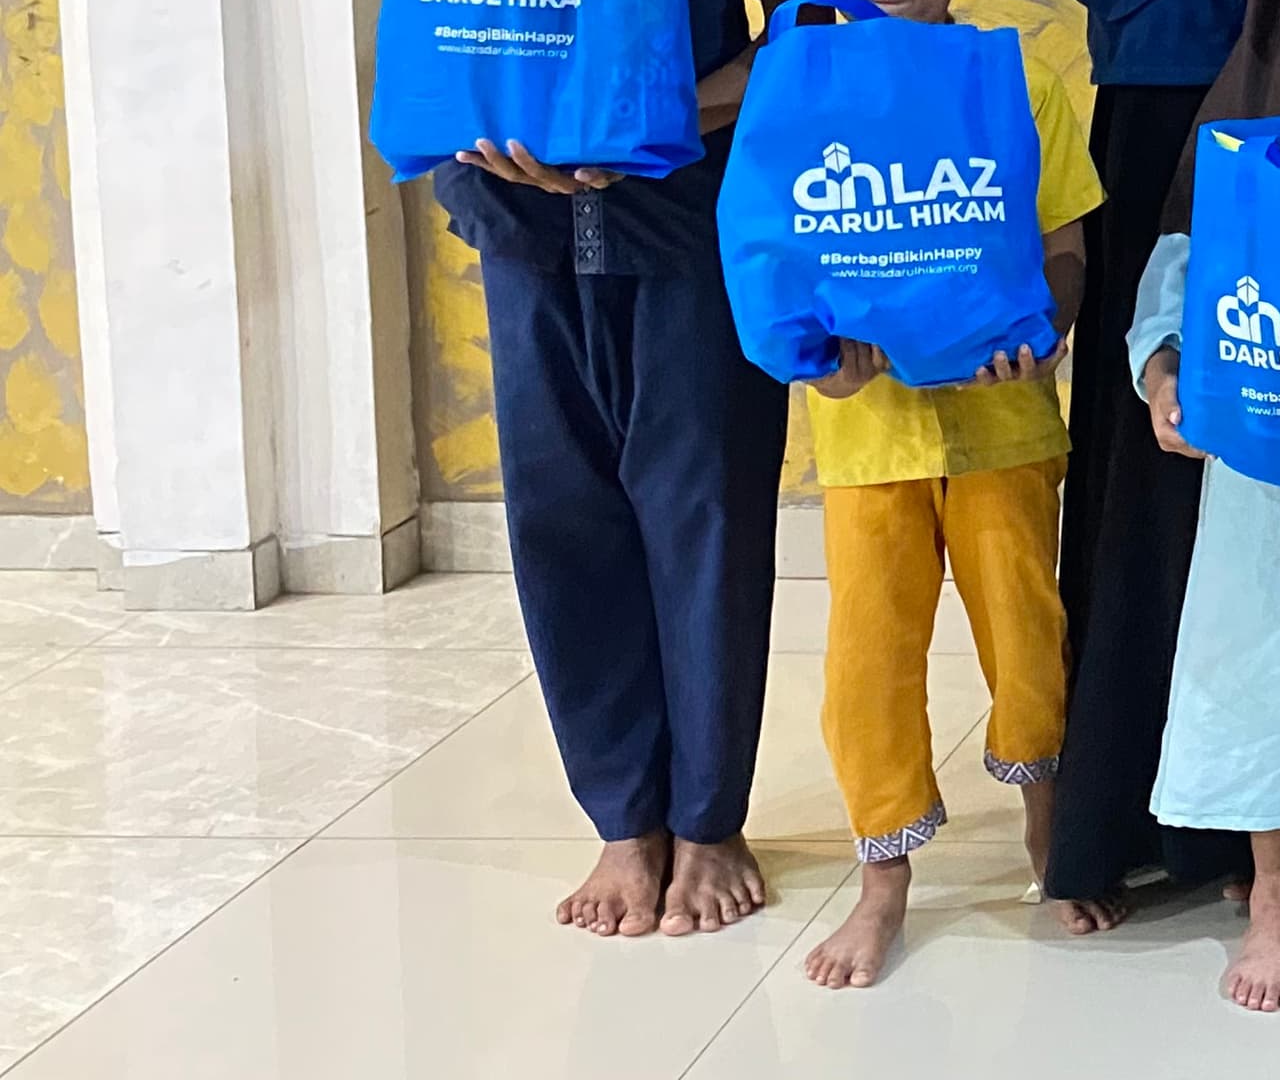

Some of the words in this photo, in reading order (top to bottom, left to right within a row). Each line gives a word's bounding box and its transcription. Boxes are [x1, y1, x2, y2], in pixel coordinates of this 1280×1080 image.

[434, 26, 574, 46] #BerbagiBikinHappy
[889, 157, 1003, 204] LAZ
[794, 209, 903, 234] DARUL
[910, 200, 1005, 227] HIKAM
[820, 247, 982, 266] #BerbagiBikinHappy
